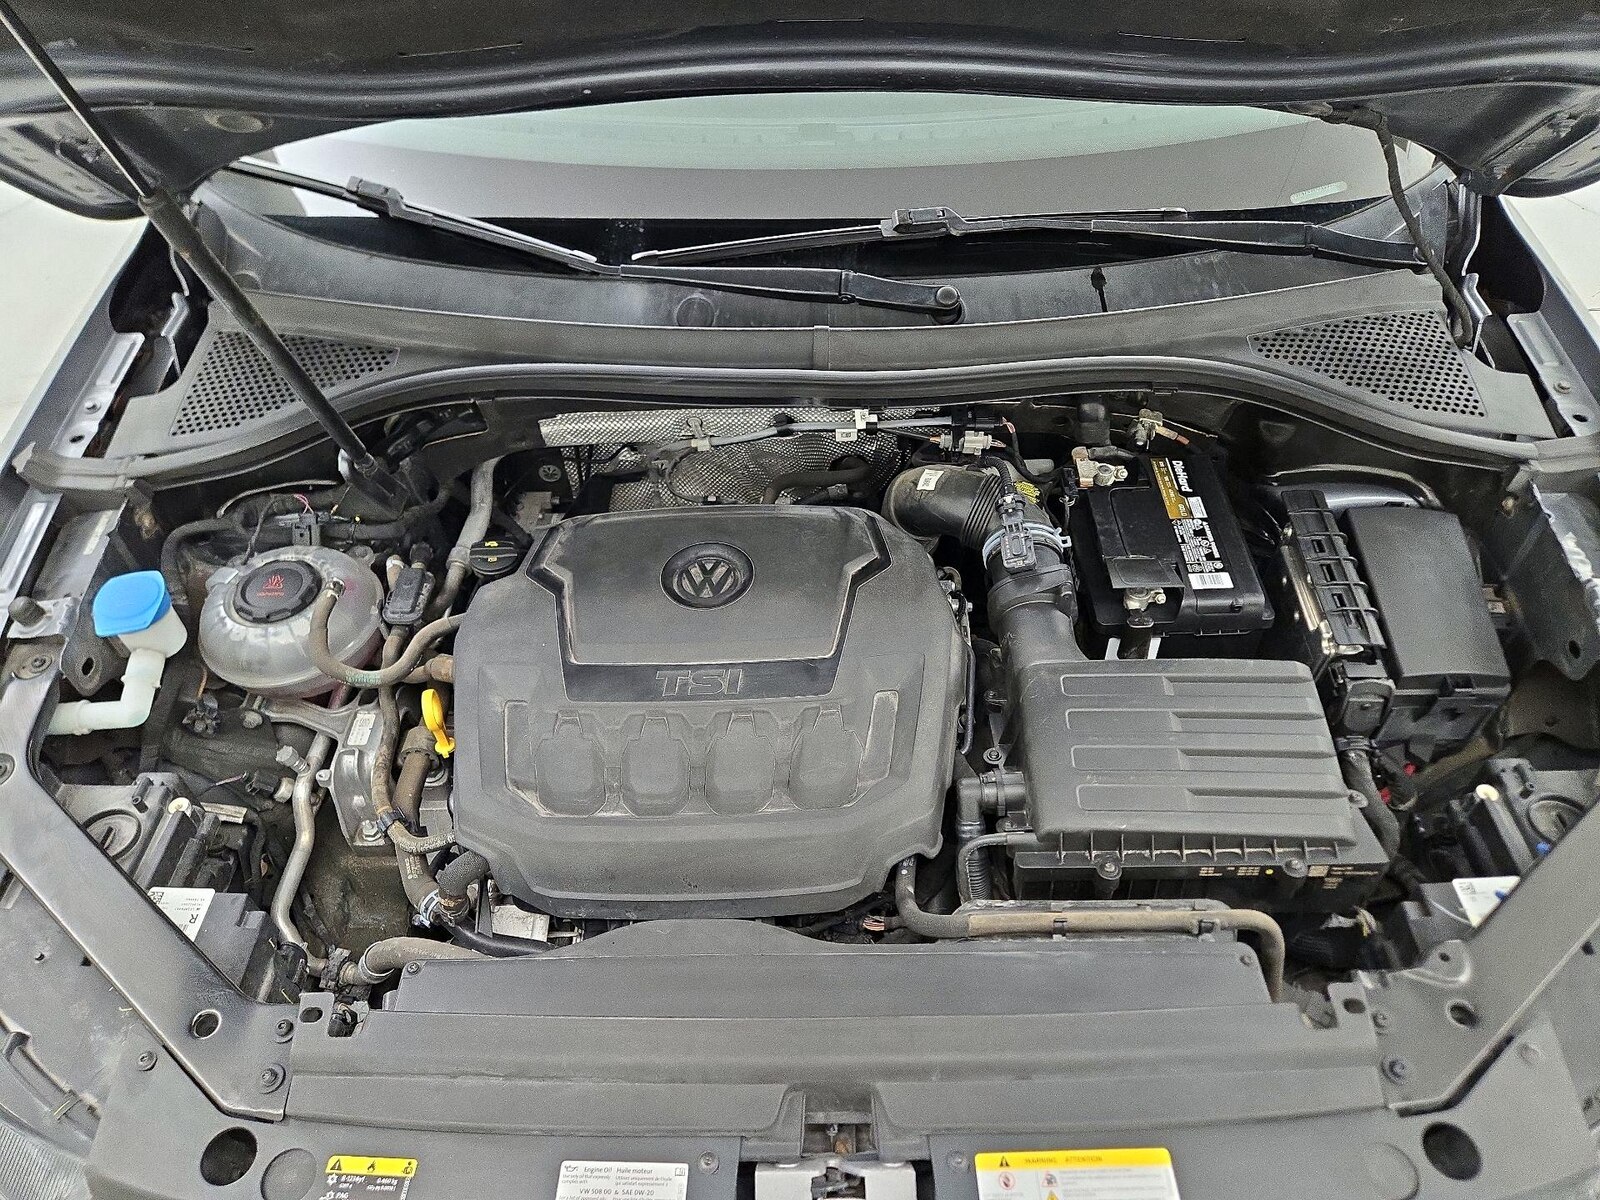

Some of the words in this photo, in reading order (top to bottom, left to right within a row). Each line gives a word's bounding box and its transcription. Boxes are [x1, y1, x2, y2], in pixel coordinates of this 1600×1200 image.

[1172, 460, 1193, 492] DieHard
[1178, 503, 1188, 517] GOLD
[676, 557, 740, 599] VW
[655, 668, 743, 697] TSI
[189, 914, 199, 924] R
[584, 1166, 603, 1174] Engine
